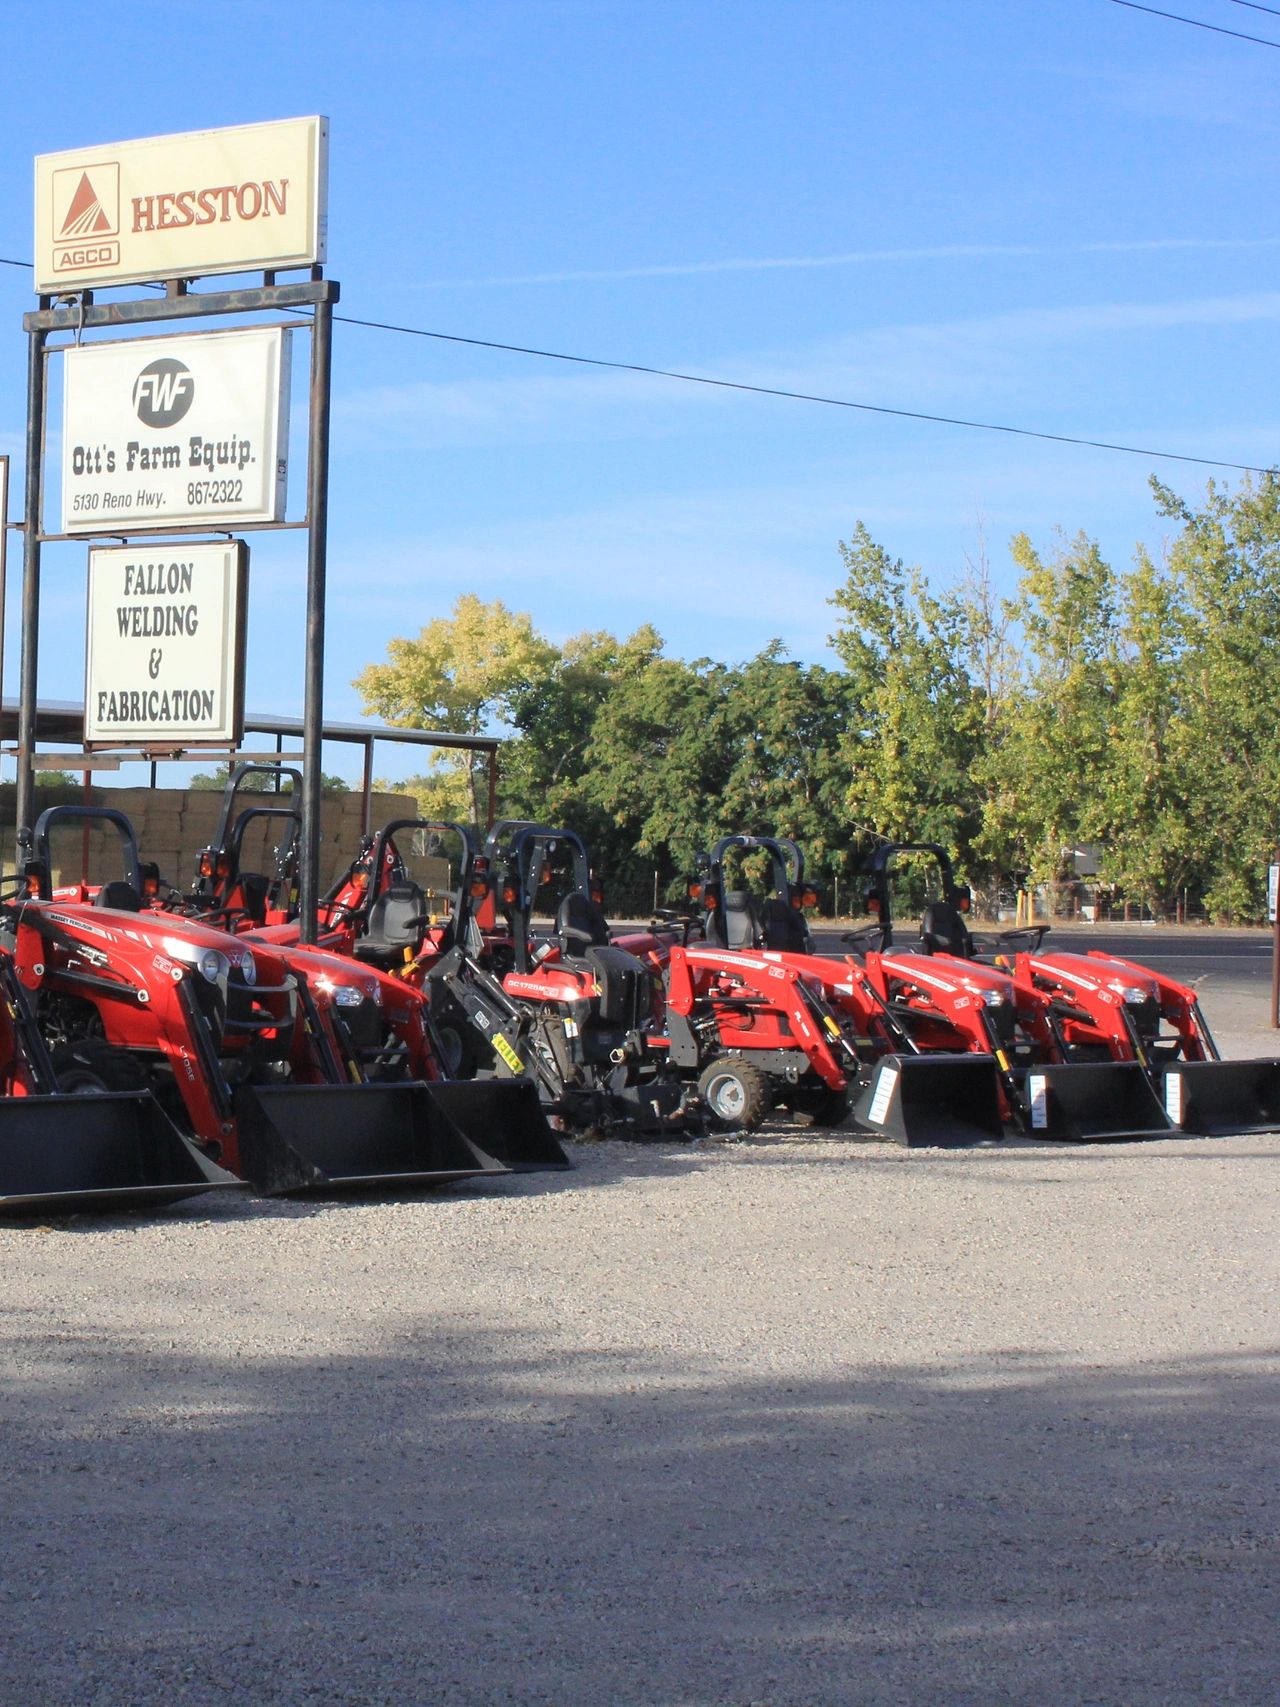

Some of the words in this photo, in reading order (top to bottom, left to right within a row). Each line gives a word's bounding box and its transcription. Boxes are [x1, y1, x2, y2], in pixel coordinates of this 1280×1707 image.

[131, 179, 289, 233] HESSTON
[60, 248, 112, 267] AGCO
[134, 370, 194, 413] FWF
[73, 444, 116, 475] Ott's
[126, 441, 181, 472] Farm
[189, 434, 256, 473] Equip.
[73, 493, 99, 511] 5130
[103, 491, 132, 509] Reno
[137, 489, 167, 509] Hwy.
[187, 479, 243, 506] 867-2322
[124, 562, 194, 596] FALLON
[117, 605, 199, 637] WELDING
[148, 648, 163, 680] &
[97, 690, 215, 722] FABRICATION
